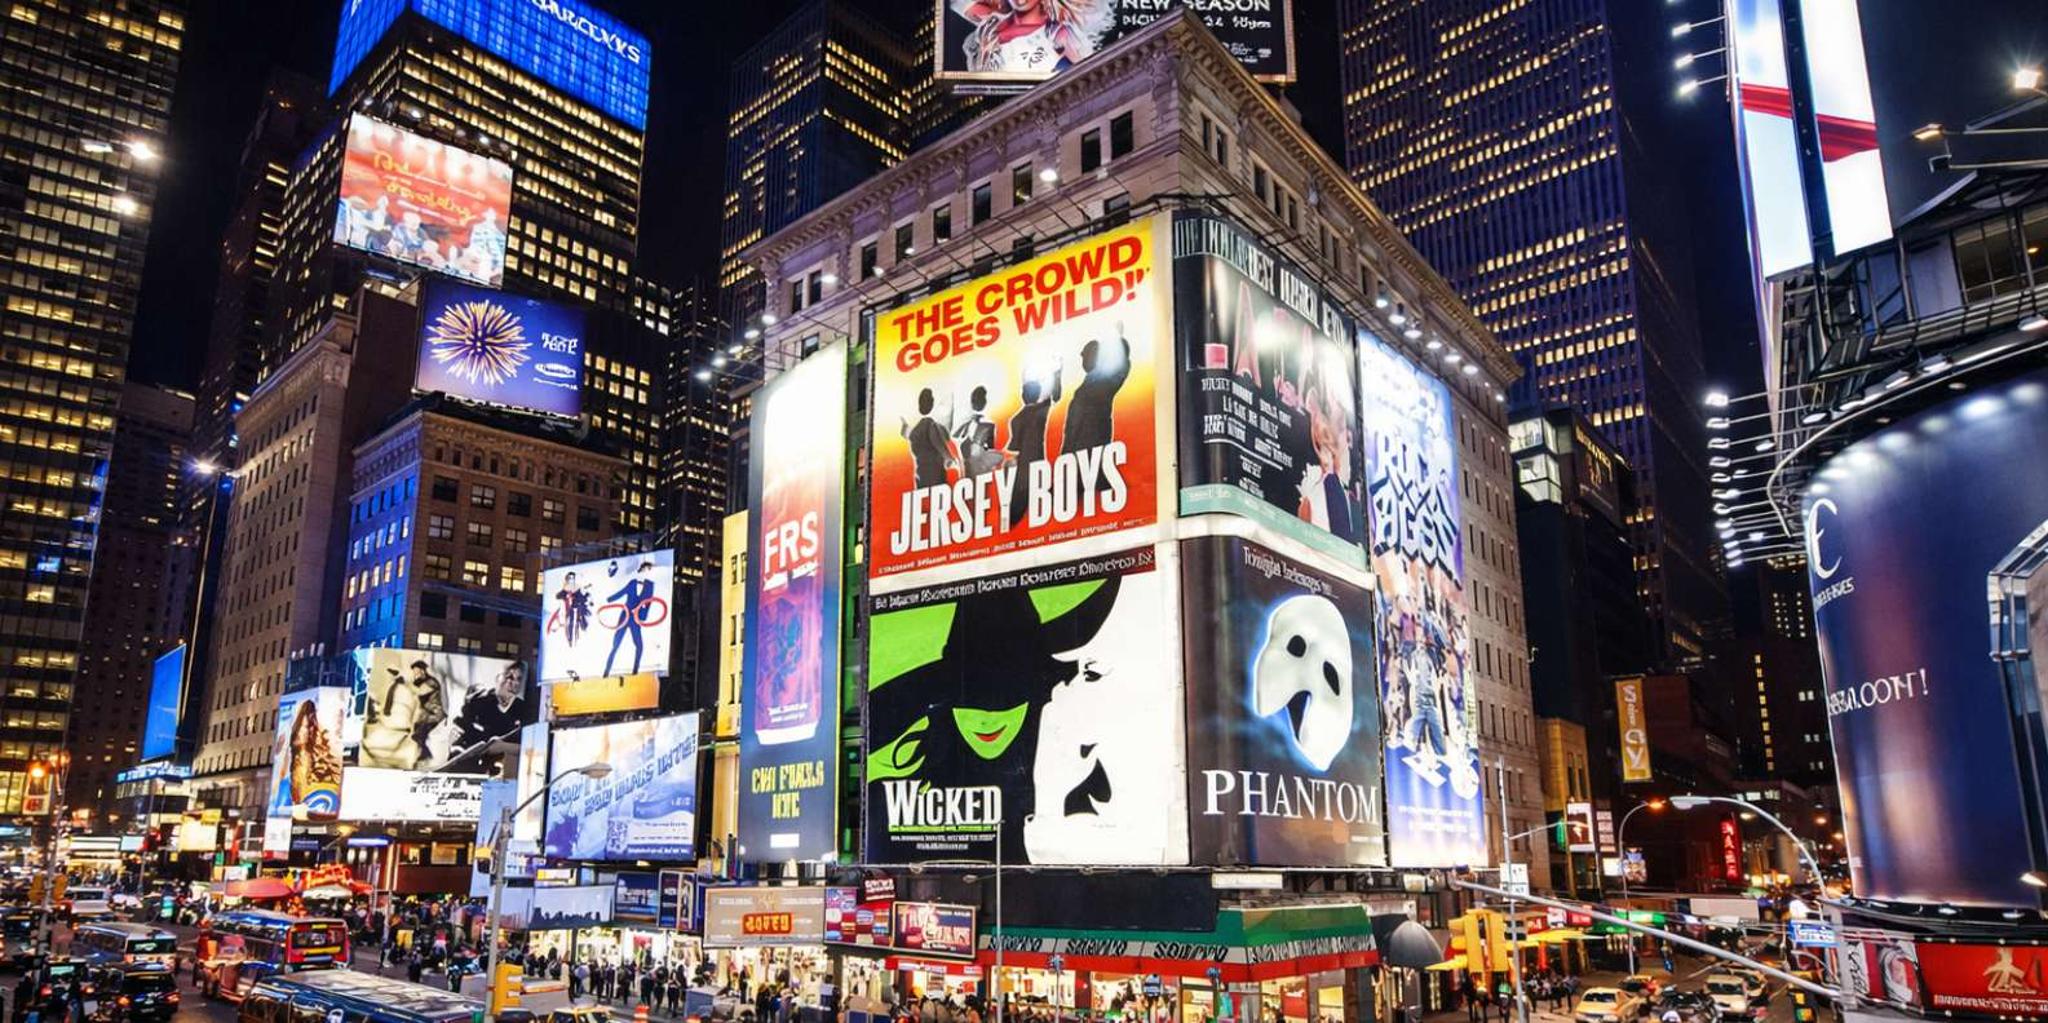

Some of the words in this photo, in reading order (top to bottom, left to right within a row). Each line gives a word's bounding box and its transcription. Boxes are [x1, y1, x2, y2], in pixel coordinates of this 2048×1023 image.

[893, 294, 964, 342] THE
[976, 235, 1143, 316] CROWD
[896, 316, 1000, 373] GOES
[890, 466, 1018, 556] JERSEY
[1029, 441, 1128, 529] BOYS
[764, 511, 819, 577] FRS
[1202, 769, 1380, 825] PHANTOM
